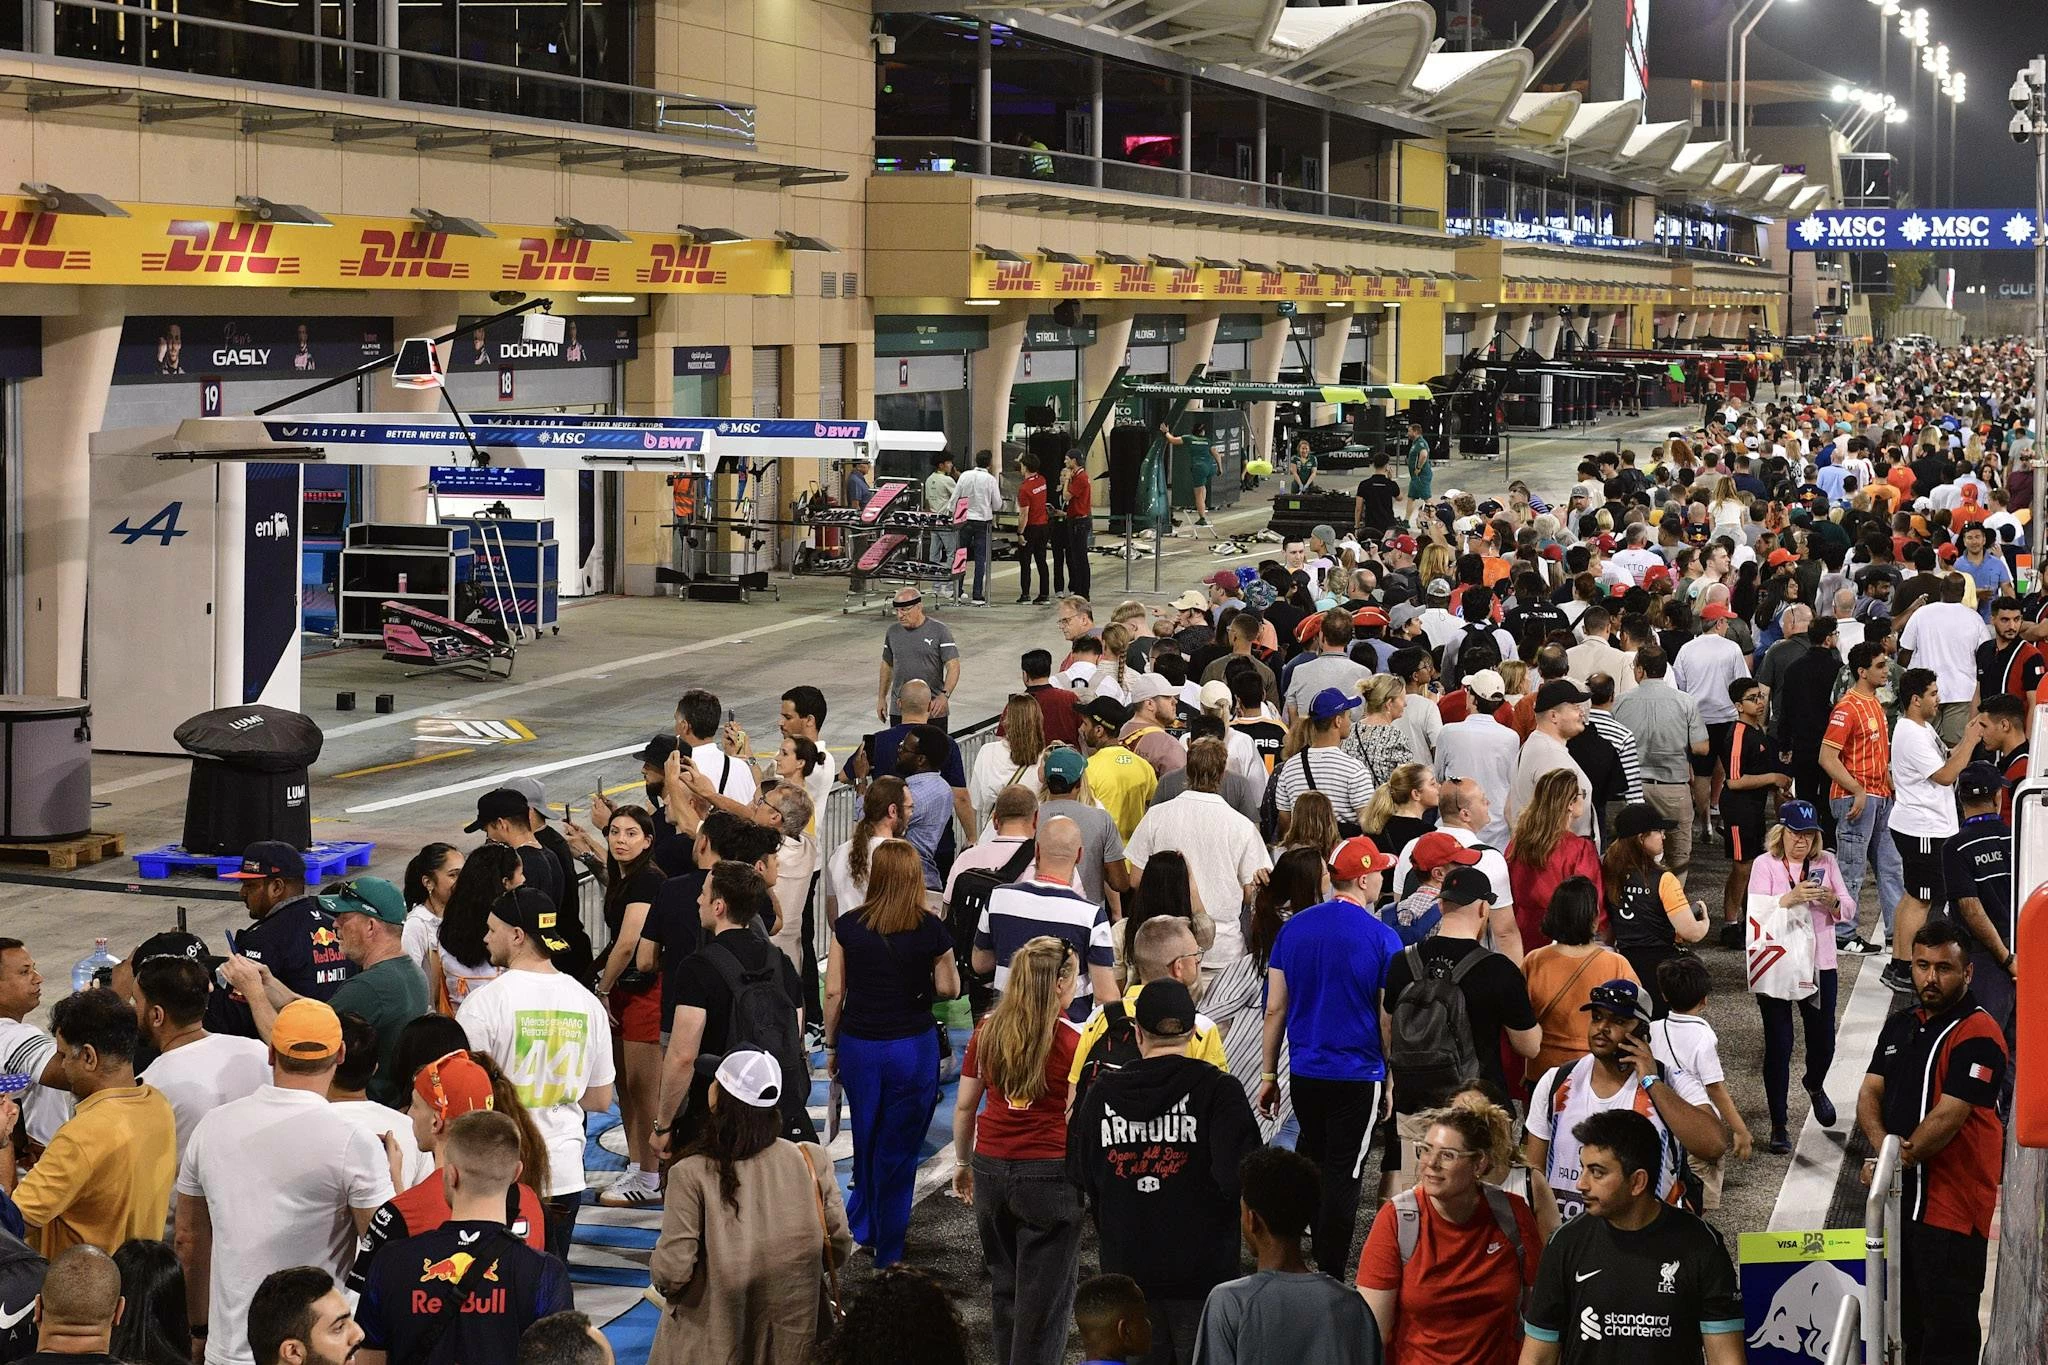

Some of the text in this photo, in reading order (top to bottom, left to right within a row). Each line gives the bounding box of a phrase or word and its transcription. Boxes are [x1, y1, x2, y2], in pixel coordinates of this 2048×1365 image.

[1828, 216, 1886, 238] MSC
[1931, 216, 1989, 238] MSC
[0, 211, 66, 269] HL
[165, 219, 280, 273] DHL
[1827, 239, 1886, 247] CRUISES
[1930, 239, 1989, 247] CRUISES
[359, 229, 452, 279] DHL
[518, 238, 595, 281] DHL
[650, 244, 715, 284] DHL
[996, 262, 1034, 291] DHL
[1061, 264, 1096, 292] DHL
[1120, 266, 1151, 292] DHL
[1172, 269, 1199, 294] DHL
[1219, 270, 1242, 295] DHL
[1261, 272, 1283, 295] DHL
[1036, 332, 1060, 342] STROLL
[1135, 330, 1157, 339] ALONSO
[213, 349, 271, 366] GASLY
[500, 343, 559, 359] DOOHAN
[501, 373, 512, 394] 18
[205, 385, 218, 411] 19
[302, 428, 366, 438] CASTORE
[386, 430, 418, 439] BETTER
[419, 431, 448, 441] NEVER
[730, 423, 760, 434] MSC
[827, 426, 860, 437] BWT
[551, 432, 585, 444] MSC
[658, 436, 695, 449] BWT
[255, 515, 274, 538] eni
[411, 620, 443, 634] INFINOX
[229, 714, 264, 730] LUMI
[1255, 738, 1280, 748] RIS
[1115, 754, 1133, 764] 46
[287, 784, 306, 799] LUMI
[1799, 806, 1813, 819] W
[1975, 851, 2003, 866] POLICE
[245, 949, 262, 960] VISA
[313, 948, 329, 964] Red
[317, 970, 337, 984] Mobil
[521, 1017, 583, 1029] Mercedes-AMG
[513, 1039, 585, 1099] 44
[1101, 1114, 1198, 1147] ARMOUR
[1108, 1148, 1138, 1165] Open
[1143, 1144, 1161, 1159] All
[1115, 1160, 1181, 1178] & All Night
[1558, 1166, 1579, 1181] PAD
[1776, 1240, 1798, 1249] VISA
[411, 1289, 443, 1314] Re
[1604, 1312, 1669, 1326] standard
[1604, 1323, 1671, 1337] chartered
